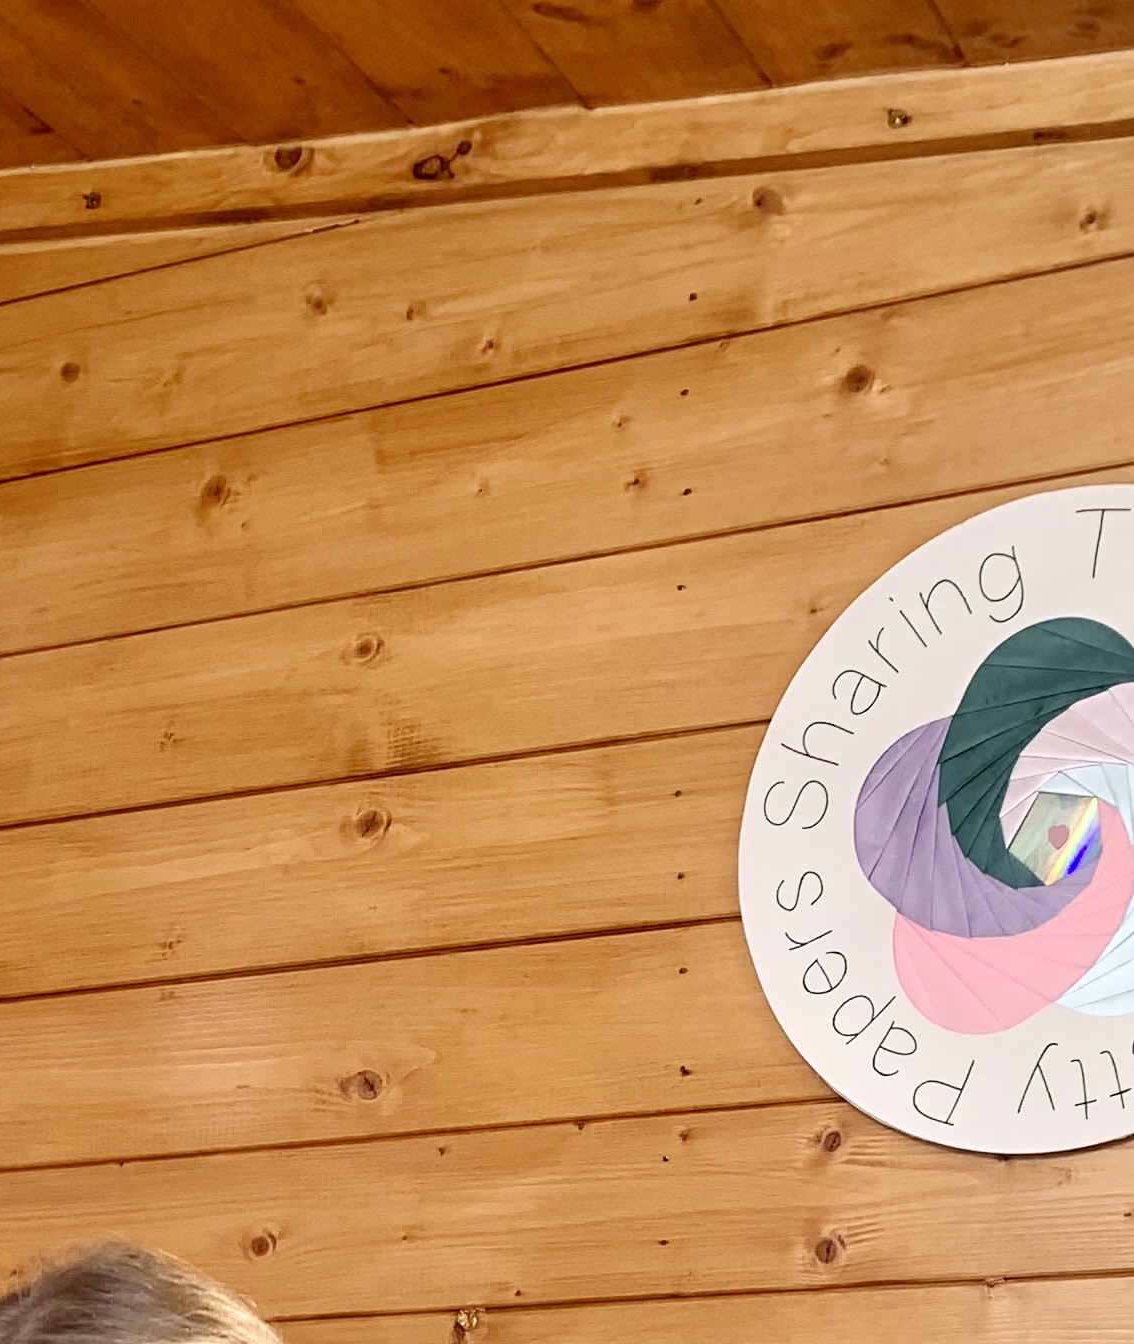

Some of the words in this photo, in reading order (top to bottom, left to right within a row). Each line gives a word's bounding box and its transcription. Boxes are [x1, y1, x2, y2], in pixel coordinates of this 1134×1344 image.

[764, 545, 1026, 830] Sharing
[776, 871, 976, 1127] Papers
[1017, 1040, 1134, 1121] tty
